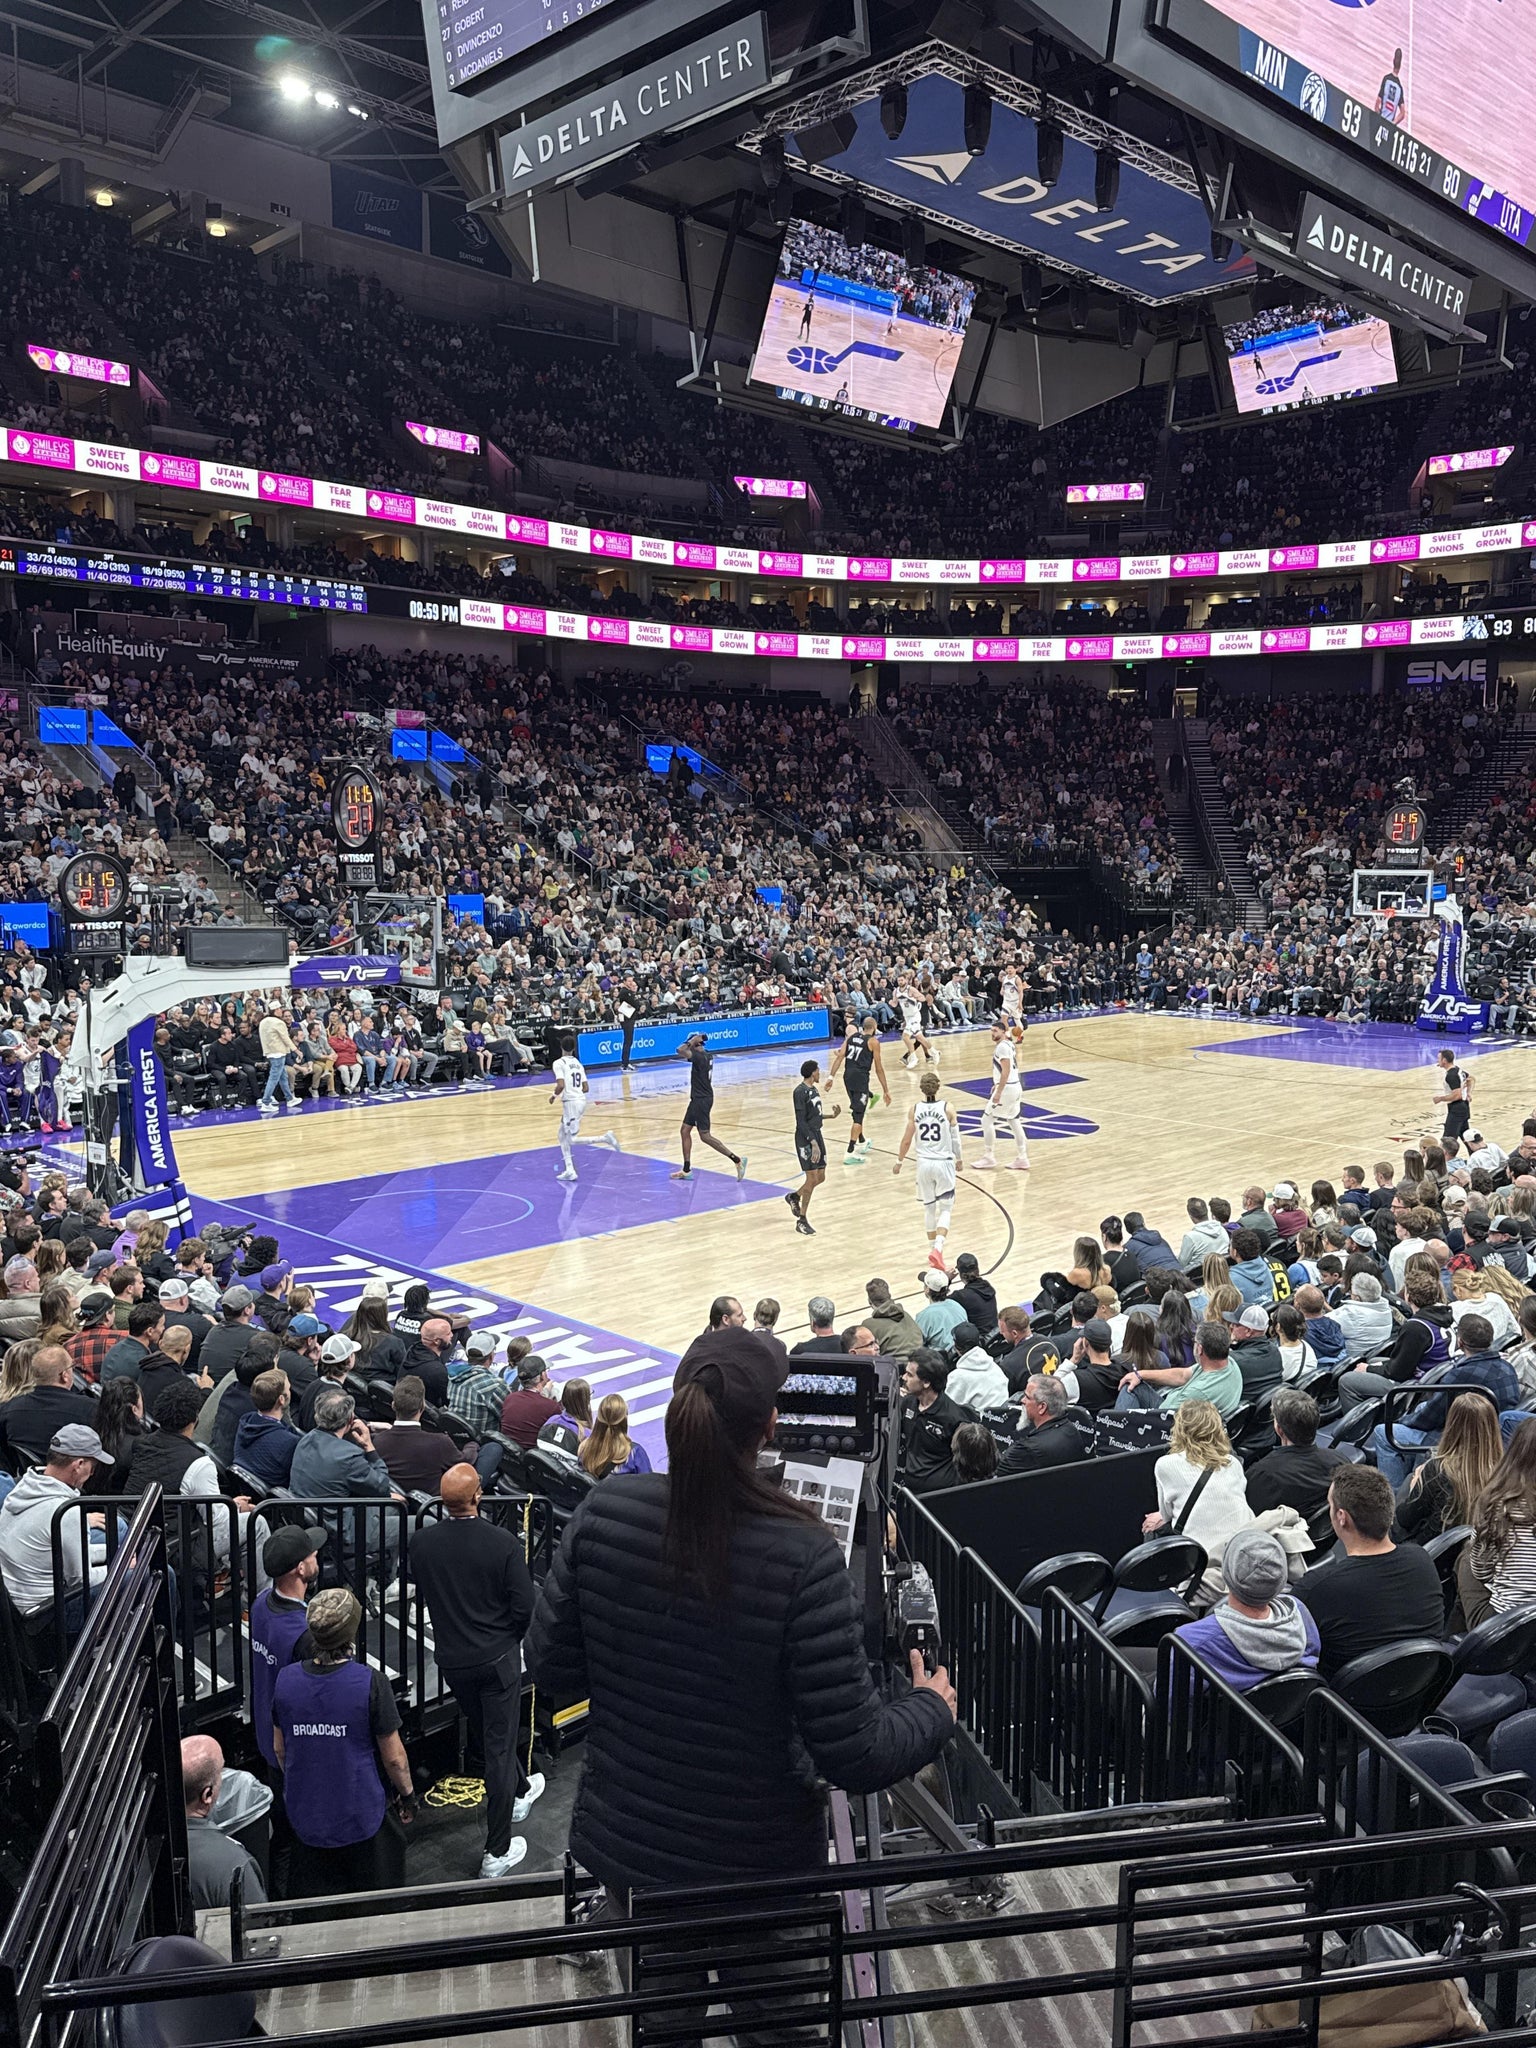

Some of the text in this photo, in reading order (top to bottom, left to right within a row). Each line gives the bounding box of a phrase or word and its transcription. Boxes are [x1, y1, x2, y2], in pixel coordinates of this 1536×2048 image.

[442, 7, 485, 42] 27 GOBERT
[446, 23, 503, 63] 0 DIVINCENZO
[449, 3, 583, 86] 3 MCDANIELS 4 5 3
[537, 38, 753, 164] DELTA CENTER
[1255, 41, 1521, 238] MIN 93 11:15 21 80 UTA
[978, 176, 1207, 275] DELTA
[1329, 225, 1464, 316] DELTA CENTER
[781, 388, 911, 430] MIN 93 80 UTA
[33, 438, 70, 454] SMILEYS
[89, 447, 126, 461] SWEET
[86, 458, 130, 473] ONIONS
[162, 459, 195, 473] SMILEYS
[216, 466, 244, 479] UTAH
[210, 477, 250, 491] GROWN
[329, 486, 352, 497] TEAR
[330, 498, 351, 509] FREE
[426, 502, 454, 514] SWEET
[424, 514, 457, 527] ONIONS
[471, 511, 493, 522] UTAH
[466, 521, 498, 533] GROWN
[560, 527, 578, 537] TEAR
[1432, 533, 1462, 543] SWEET
[1482, 528, 1507, 538] UTAH
[561, 537, 578, 546] FREE
[641, 541, 665, 550] SWEET
[1475, 537, 1512, 548] GROWN
[1334, 544, 1356, 552] TEAR
[1429, 543, 1464, 554] ONIONS
[1, 549, 13, 559] 21
[639, 549, 667, 560] ONIONS
[727, 550, 749, 558] UTAH
[1232, 552, 1257, 560] UTAH
[1335, 554, 1355, 563] FREE
[0, 561, 15, 571] 4TH
[723, 559, 753, 568] GROWN
[816, 557, 835, 565] TEAR
[1038, 562, 1059, 570] TEAR
[1131, 559, 1159, 567] SWEET
[1226, 561, 1261, 570] GROWN
[26, 552, 363, 601] 33/73 (45%) 9/29 (31%) 18/19 (95%) 27 34 14 113 102
[899, 571, 930, 579] ONIONS
[1129, 568, 1162, 576] ONIONS
[26, 564, 362, 611] 26/69 (38%) 11/40 (28%) 17/20 (85%) 14 28 42 22 15 30 102 113
[410, 600, 459, 623] 08:59 PM
[469, 604, 491, 614] UTAH
[464, 613, 496, 625] GROWN
[558, 615, 576, 624] TEAR
[1423, 620, 1453, 629] SWEET
[558, 625, 575, 634] FREE
[638, 625, 662, 635] SWEET
[1326, 628, 1347, 636] TEAR
[1493, 620, 1512, 636] 93
[636, 634, 664, 643] ONIONS
[723, 632, 744, 640] UTAH
[1224, 634, 1248, 642] UTAH
[1420, 630, 1455, 639] ONIONS
[719, 641, 749, 650] GROWN
[811, 637, 830, 645] TEAR
[1124, 639, 1152, 647] SWEET
[1326, 638, 1346, 646] FREE
[58, 634, 166, 662] HealthEquity
[812, 647, 829, 655] FREE
[1121, 647, 1154, 655] ONIONS
[893, 650, 924, 658] ONIONS
[247, 656, 300, 667] AMERICA FIRST
[1407, 658, 1487, 685] SME
[348, 784, 373, 803] 11:15
[347, 805, 373, 838] 21
[1394, 813, 1418, 823] 11:15
[1392, 823, 1416, 841] 21
[349, 853, 374, 863] TISSOT
[78, 871, 115, 887] 11:15
[80, 888, 110, 908] 21
[12, 921, 46, 930] awardco
[86, 921, 123, 930] TISSOT
[1441, 935, 1452, 991] AMERICA FIRST
[779, 1020, 814, 1033] awardco
[707, 1028, 739, 1039] wardco
[847, 1045, 863, 1061] 27
[571, 1072, 582, 1088] 19
[140, 1048, 167, 1169] AMERICA FIRST
[915, 1111, 945, 1123] MARKKANEN
[919, 1123, 941, 1141] 23
[397, 1316, 421, 1329] ALSCO
[293, 1723, 347, 1737] BROADCAST
